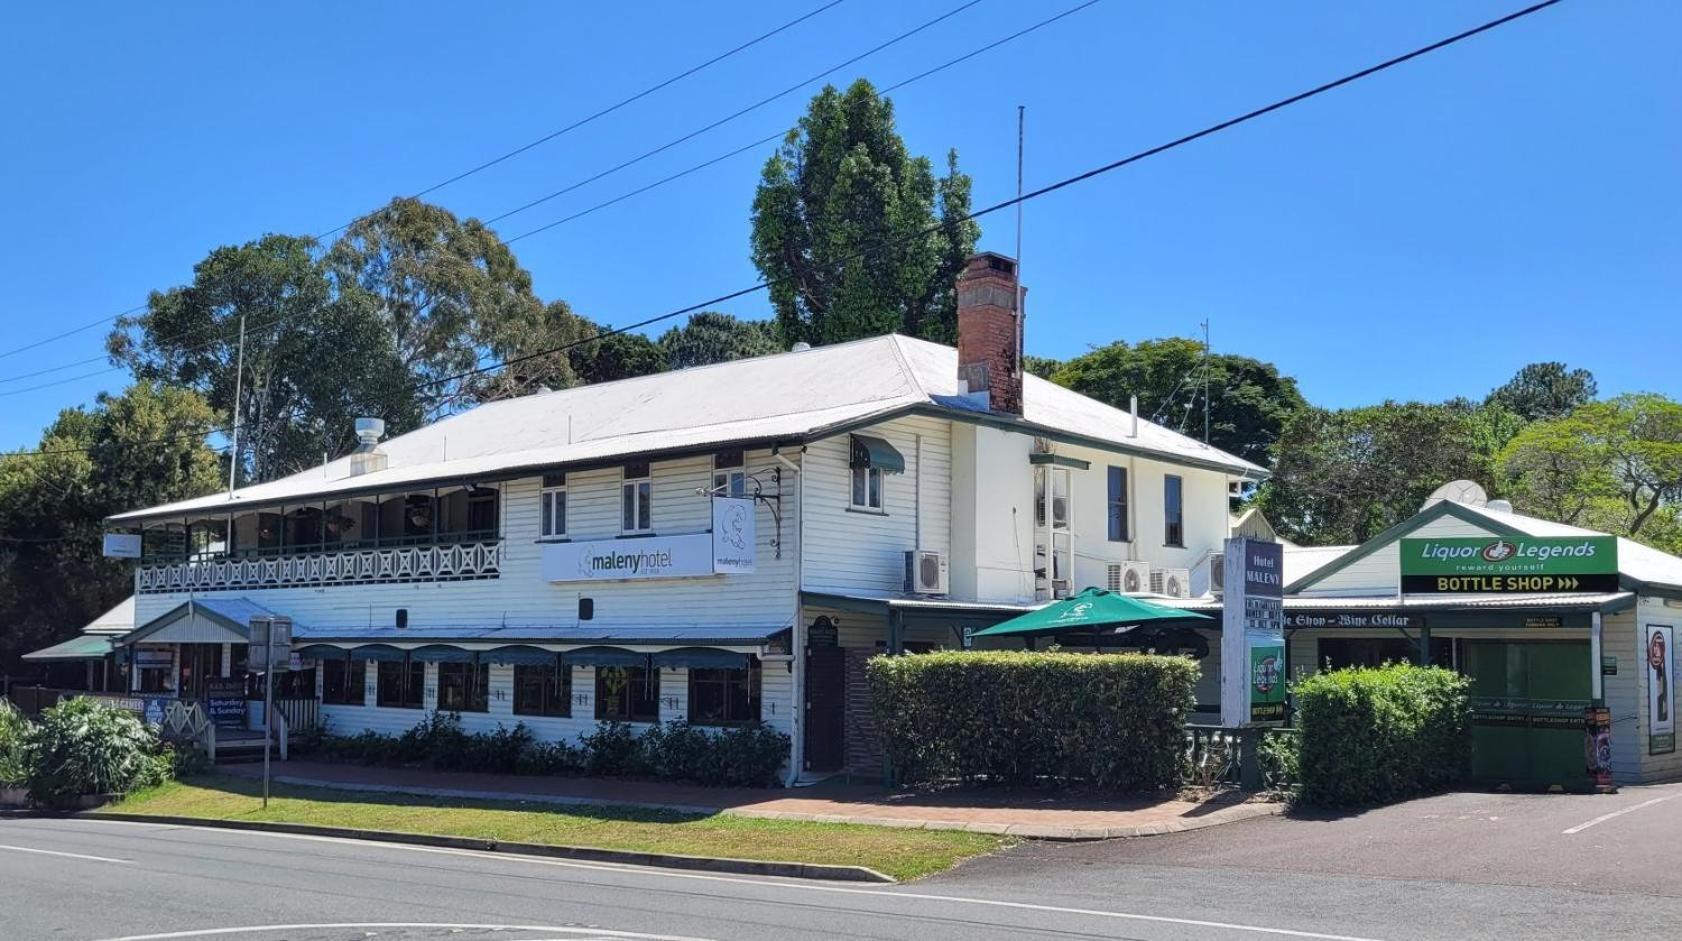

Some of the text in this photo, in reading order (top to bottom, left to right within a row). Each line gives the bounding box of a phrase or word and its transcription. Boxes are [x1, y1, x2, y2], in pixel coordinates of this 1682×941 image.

[1422, 542, 1596, 562] Liquor Legends
[1253, 555, 1274, 568] Hotel
[1498, 563, 1545, 573] yourself
[1246, 570, 1281, 585] MALENY
[1437, 577, 1553, 591] BOTTLE SHOP
[1295, 614, 1326, 627] Shop
[1338, 614, 1367, 627] Wine
[1371, 614, 1409, 626] Cellar
[210, 699, 244, 707] Saturday
[217, 707, 246, 715] Sunday
